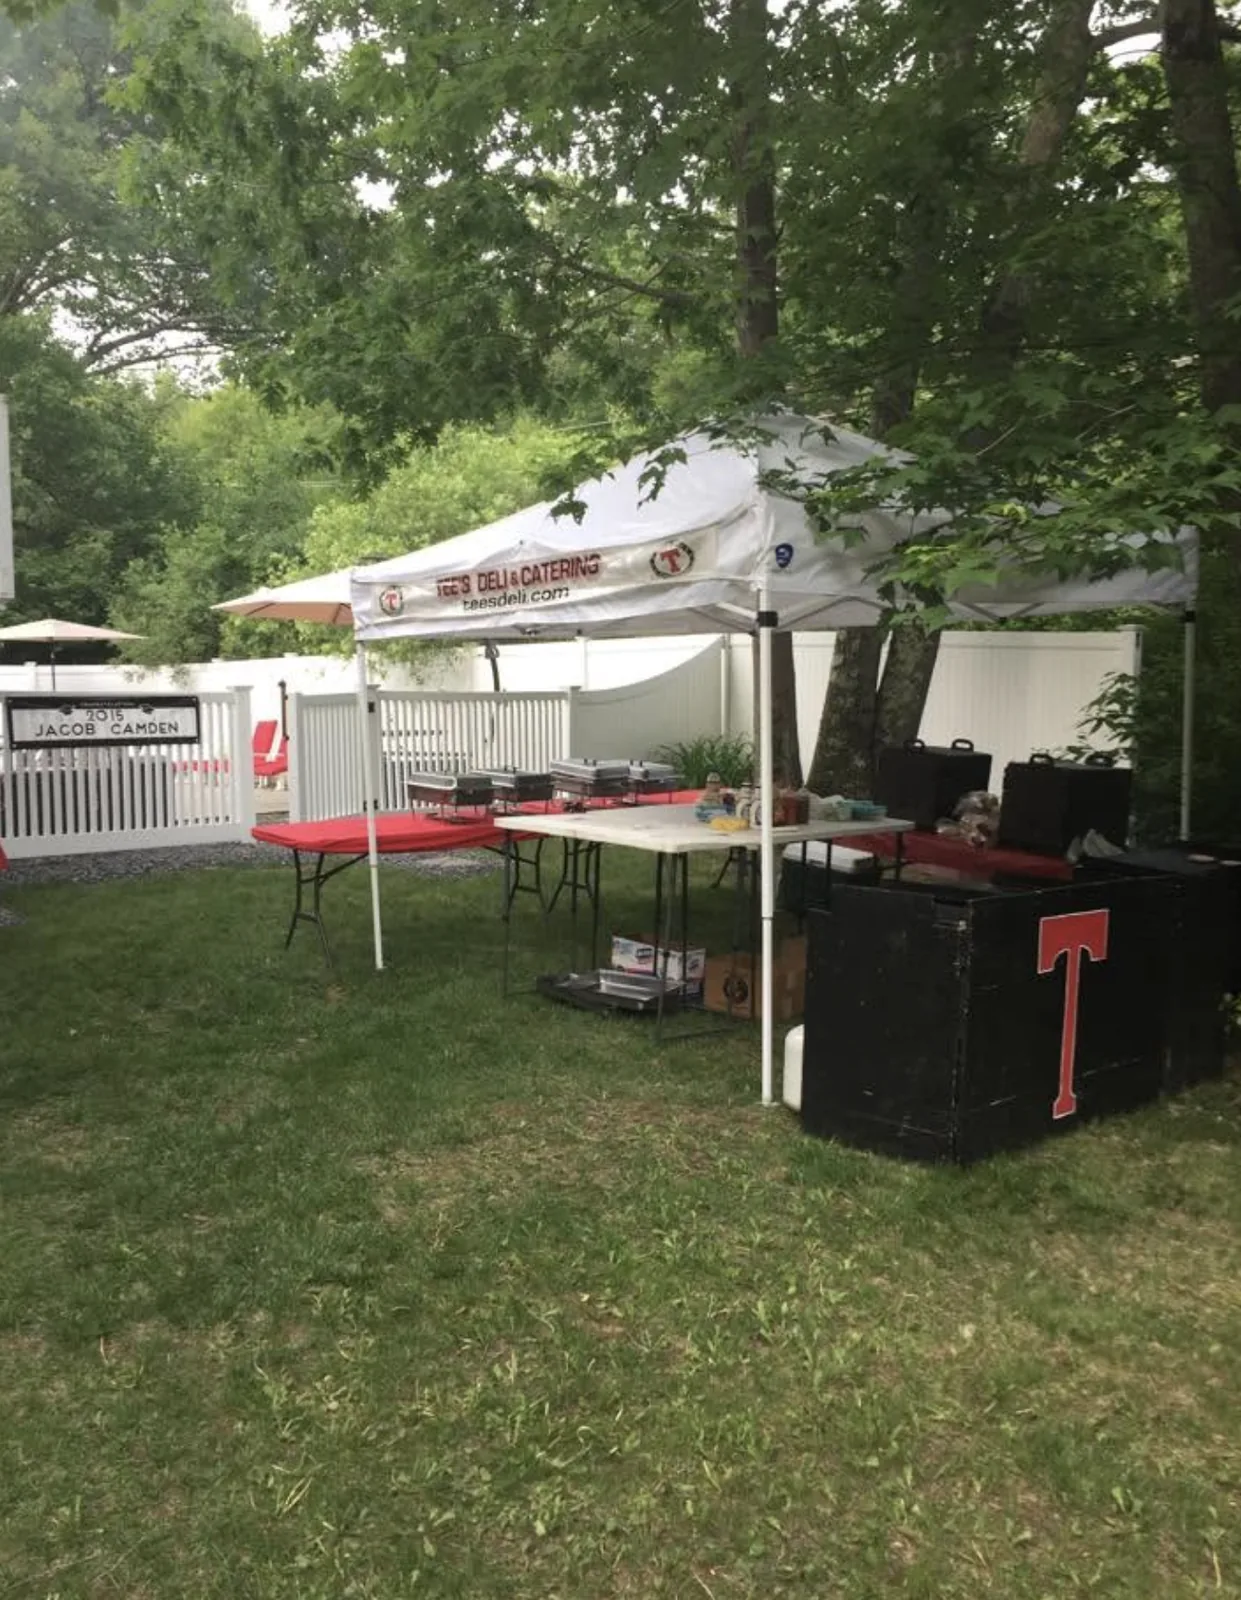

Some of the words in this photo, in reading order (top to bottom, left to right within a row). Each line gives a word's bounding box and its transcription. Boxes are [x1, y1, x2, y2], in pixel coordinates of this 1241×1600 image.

[660, 547, 681, 574] T
[436, 575, 471, 597] TEE'S
[477, 569, 507, 592] DELI
[521, 554, 601, 587] CATERING
[384, 592, 399, 611] T
[463, 586, 569, 610] teesdeli.com
[86, 709, 125, 722] 2015
[35, 723, 96, 737] JACOB
[110, 722, 179, 735] CAMDEN
[1037, 908, 1109, 1120] T
